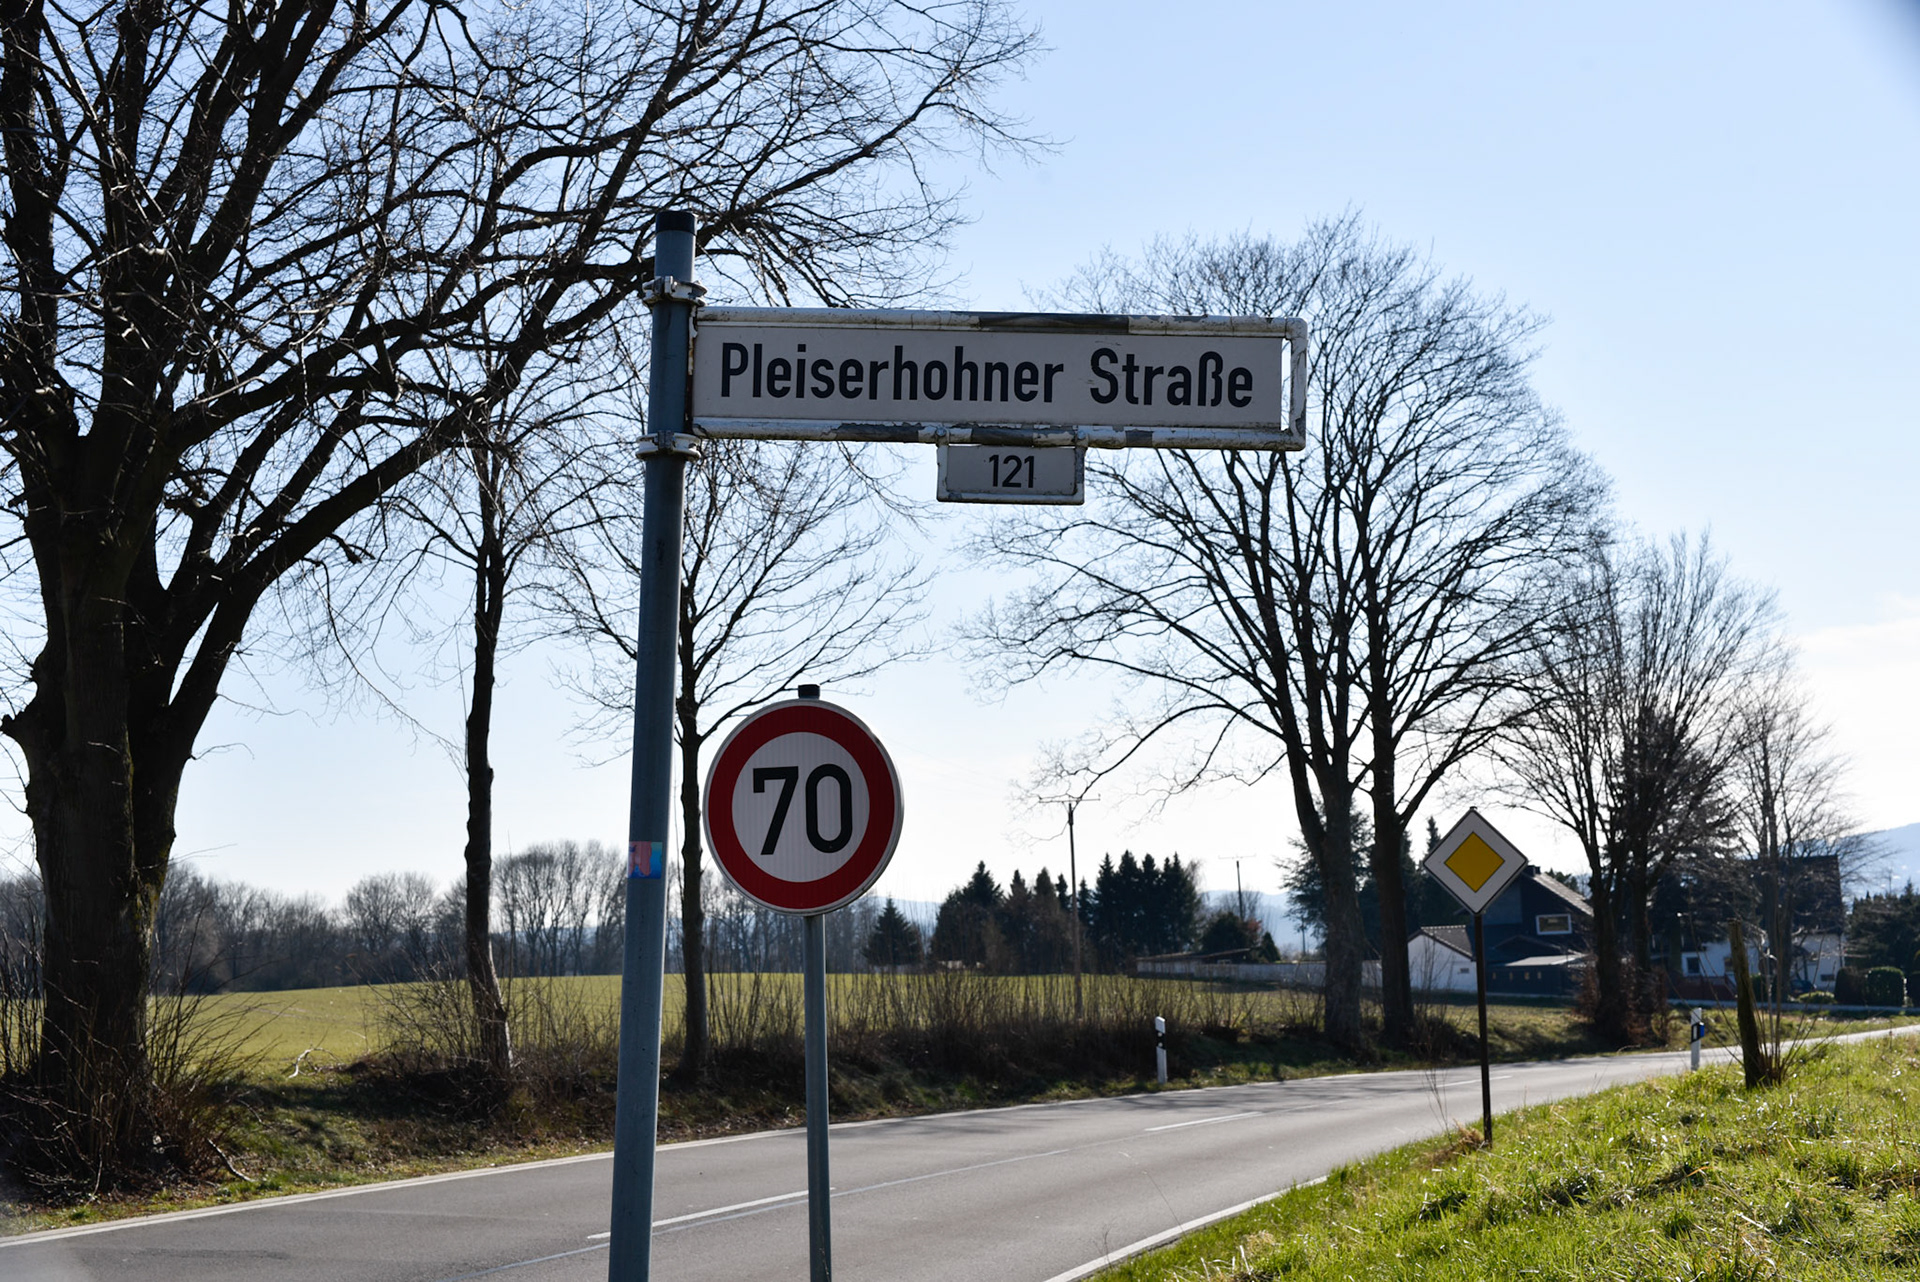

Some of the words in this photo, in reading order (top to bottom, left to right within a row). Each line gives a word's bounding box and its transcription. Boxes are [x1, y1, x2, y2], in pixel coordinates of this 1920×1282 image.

[721, 342, 1064, 404] Pleiserhohner
[1090, 347, 1253, 408] Straße
[988, 454, 1035, 489] 121
[753, 763, 853, 855] 70
